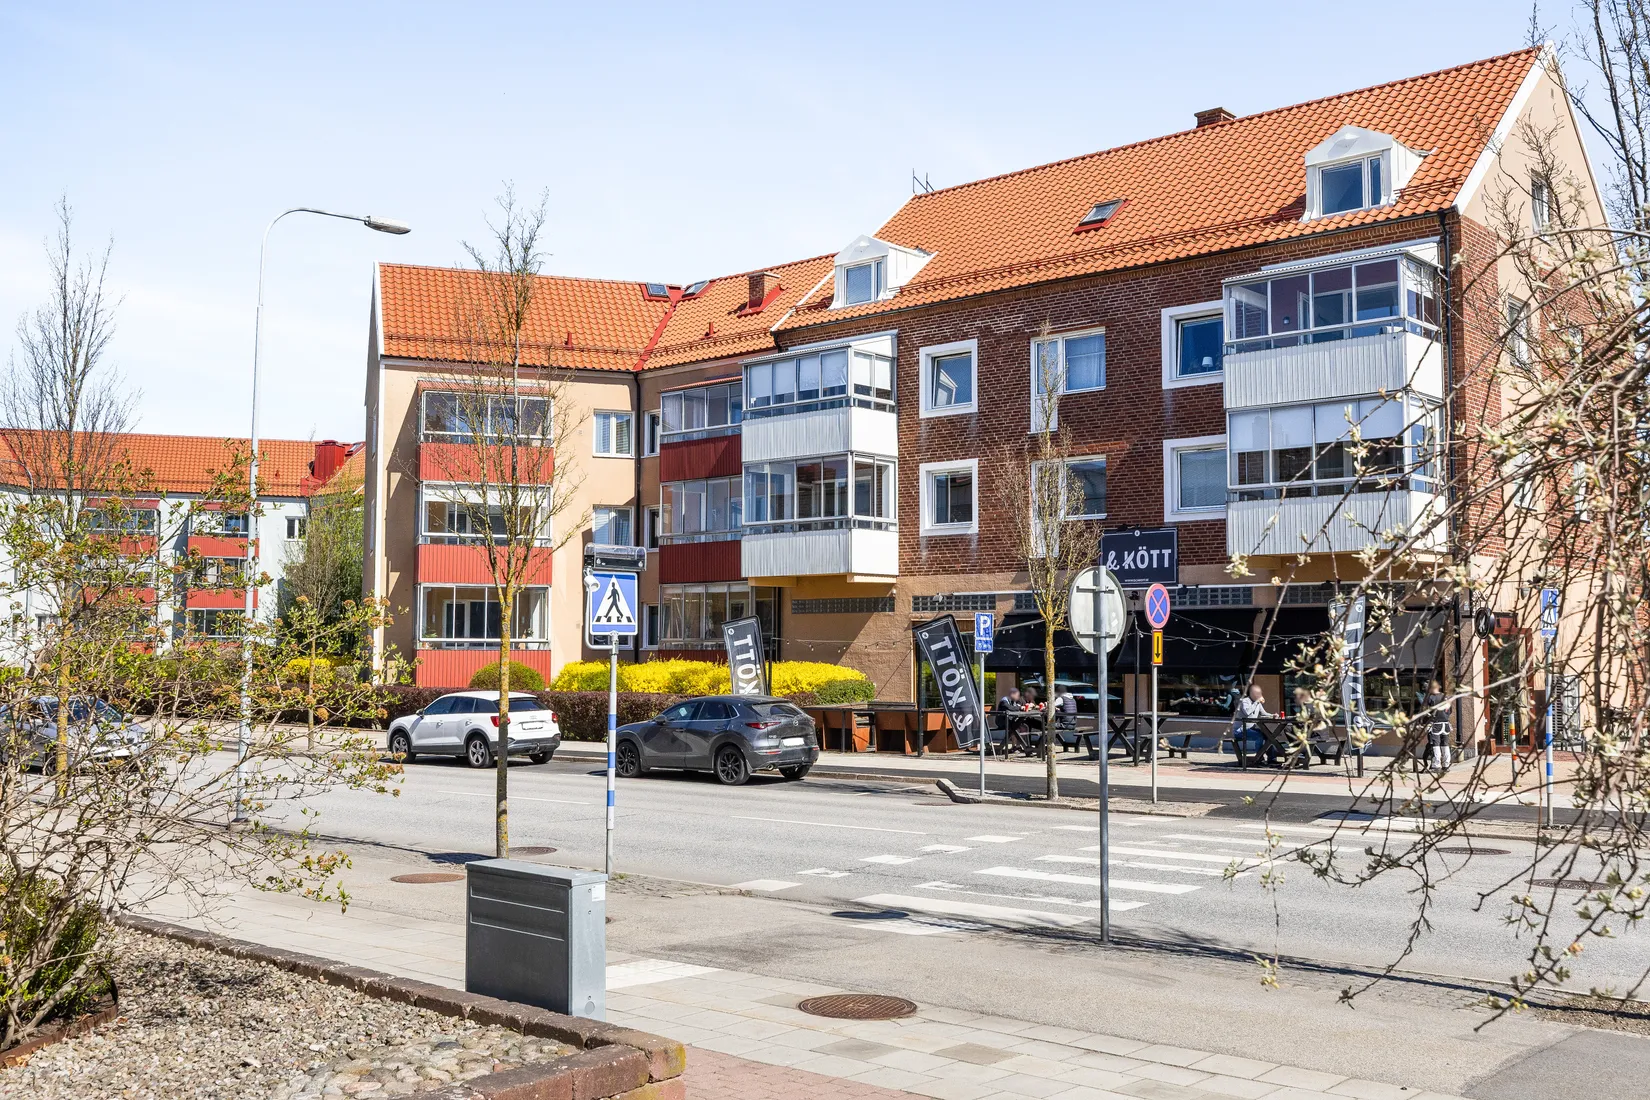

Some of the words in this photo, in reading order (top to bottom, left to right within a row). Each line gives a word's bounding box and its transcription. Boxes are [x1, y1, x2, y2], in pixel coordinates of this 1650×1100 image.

[1106, 550, 1120, 571] &
[1122, 546, 1172, 570] KÖTT
[980, 615, 991, 636] P
